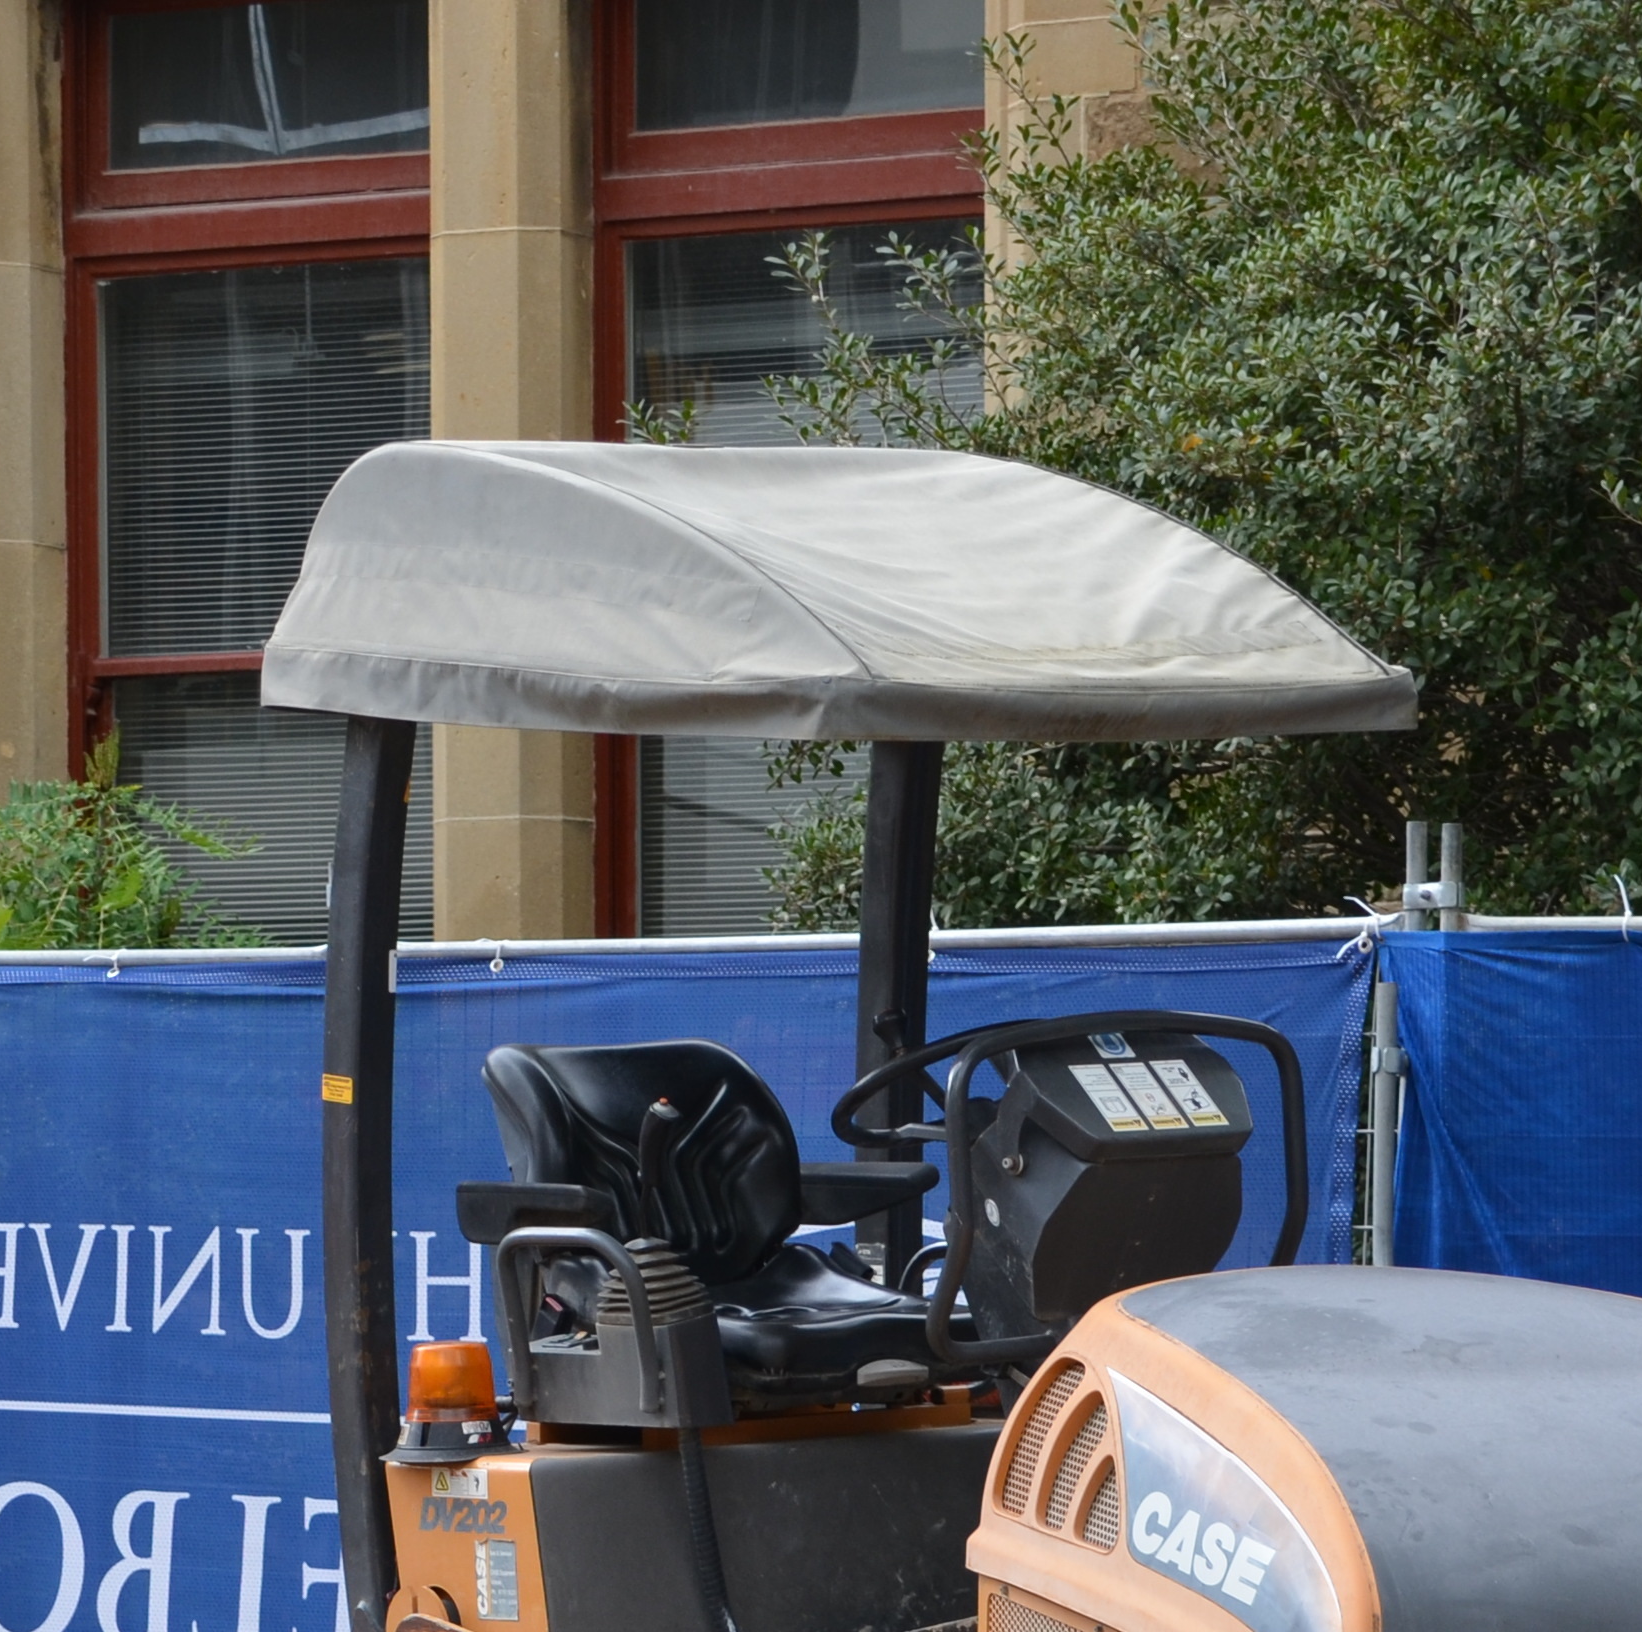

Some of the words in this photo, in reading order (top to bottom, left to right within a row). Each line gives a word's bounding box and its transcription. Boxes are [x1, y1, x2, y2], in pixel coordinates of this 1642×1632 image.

[419, 1496, 507, 1534] DV202
[1132, 1492, 1276, 1606] CASE
[476, 1541, 489, 1616] CASE
